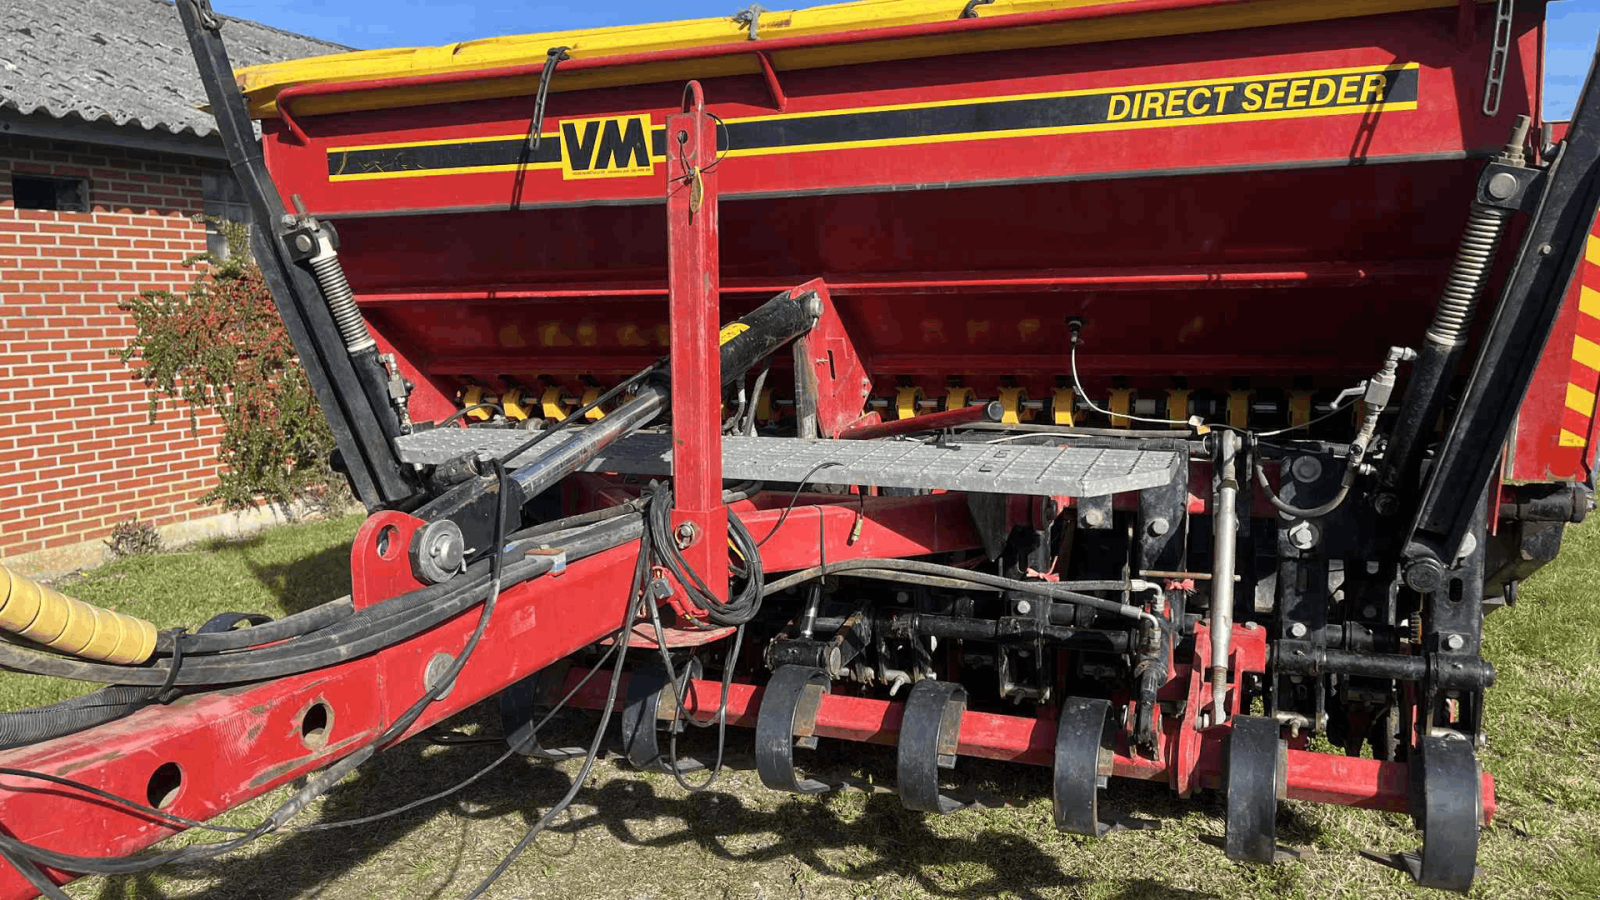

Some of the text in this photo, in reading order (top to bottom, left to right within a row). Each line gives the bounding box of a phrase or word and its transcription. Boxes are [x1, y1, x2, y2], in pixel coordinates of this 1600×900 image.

[1106, 74, 1387, 121] DIRECT SEEDER
[562, 118, 650, 170] VM
